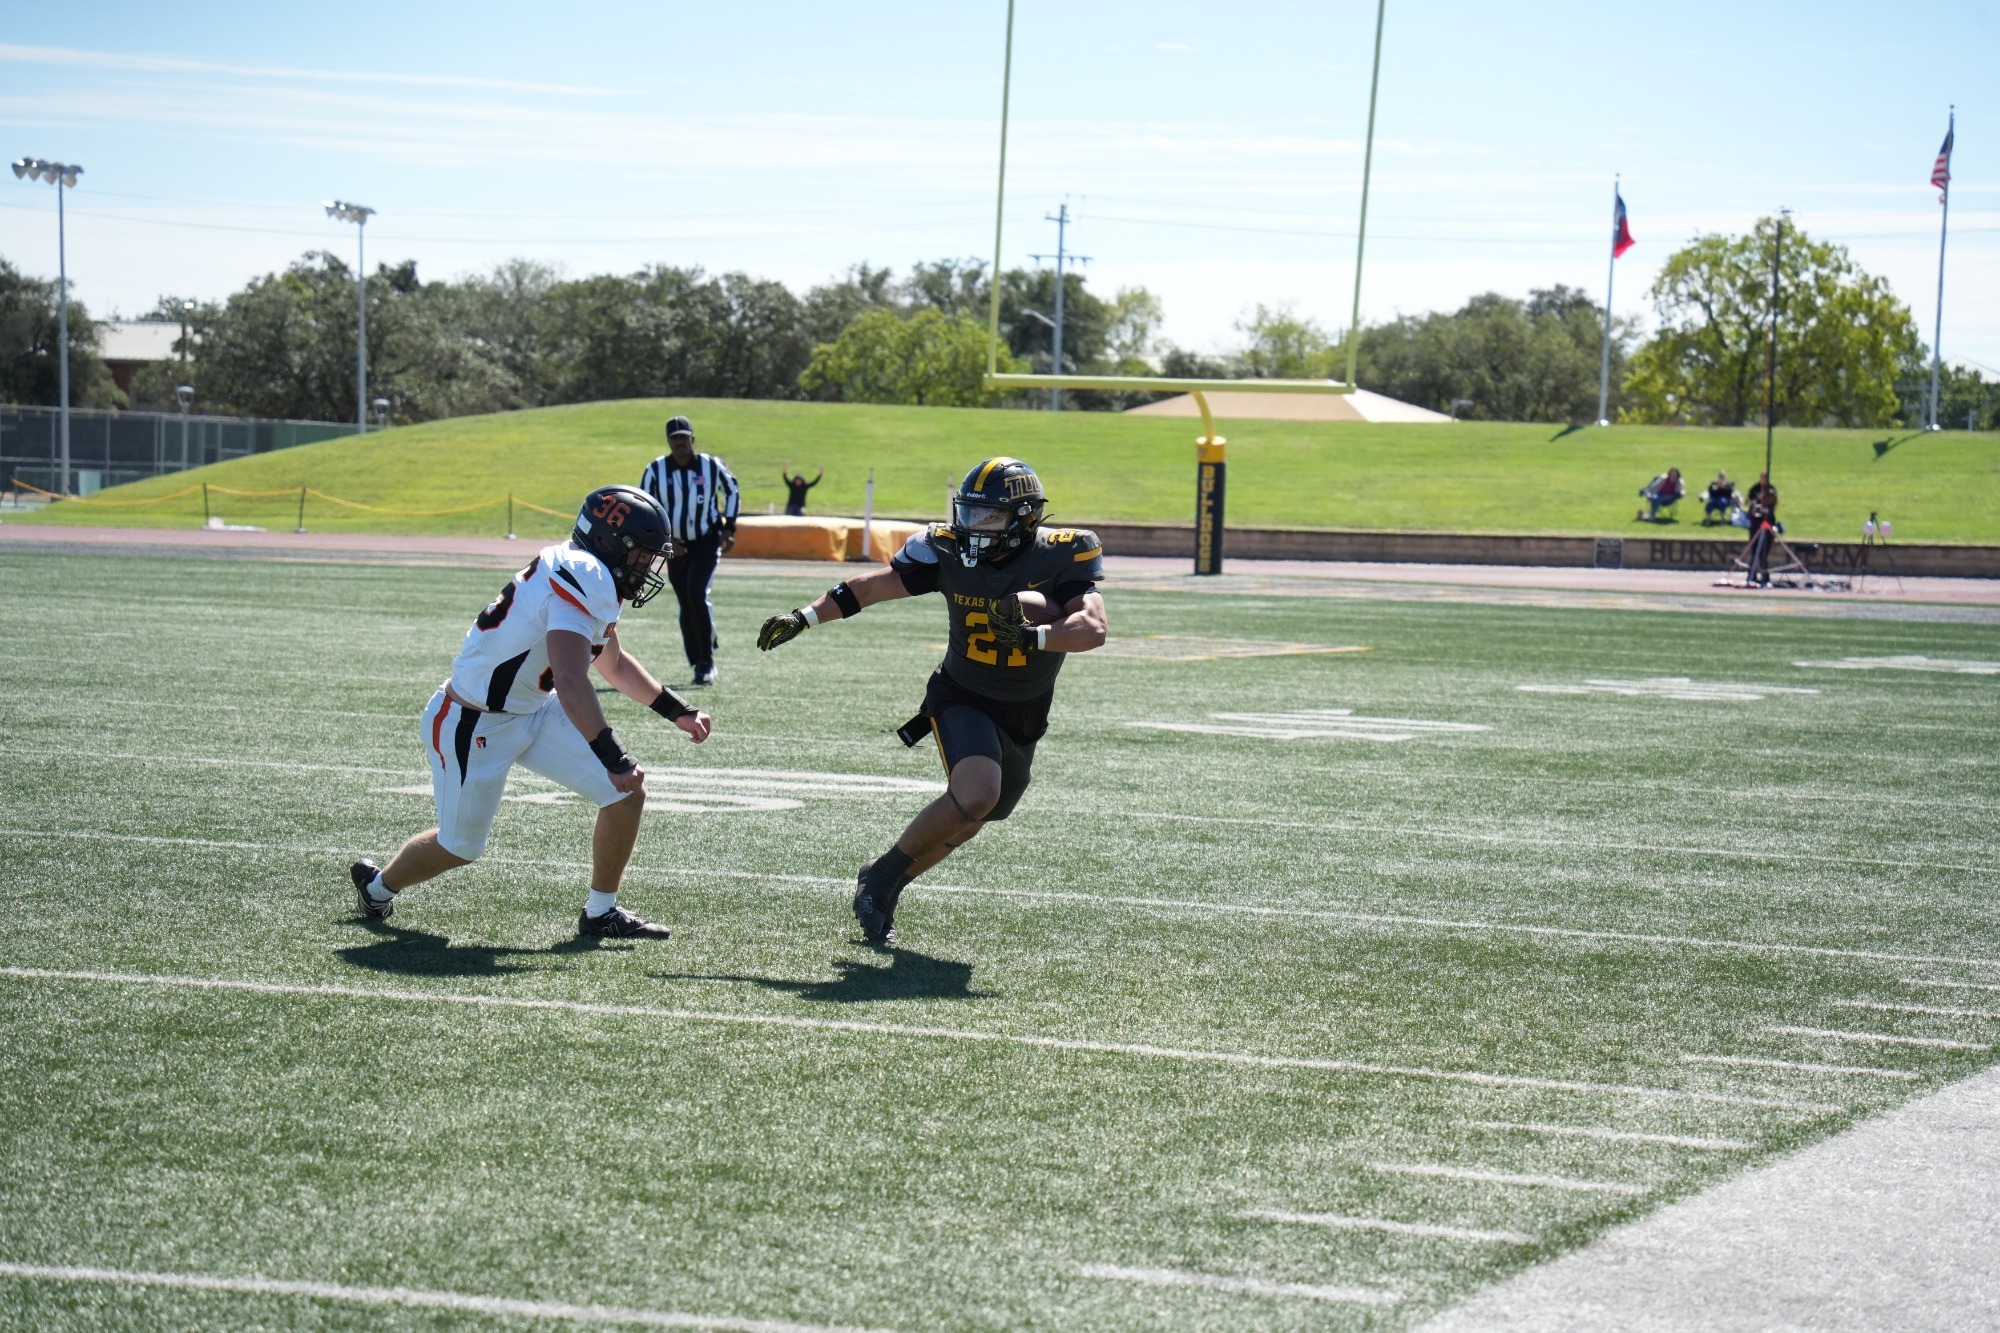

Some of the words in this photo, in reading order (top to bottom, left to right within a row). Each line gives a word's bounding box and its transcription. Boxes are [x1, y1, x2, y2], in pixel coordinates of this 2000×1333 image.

[1004, 474, 1041, 499] TLU
[593, 495, 631, 527] 36
[1199, 465, 1215, 573] BULLDOGS
[953, 593, 985, 607] TEXAS
